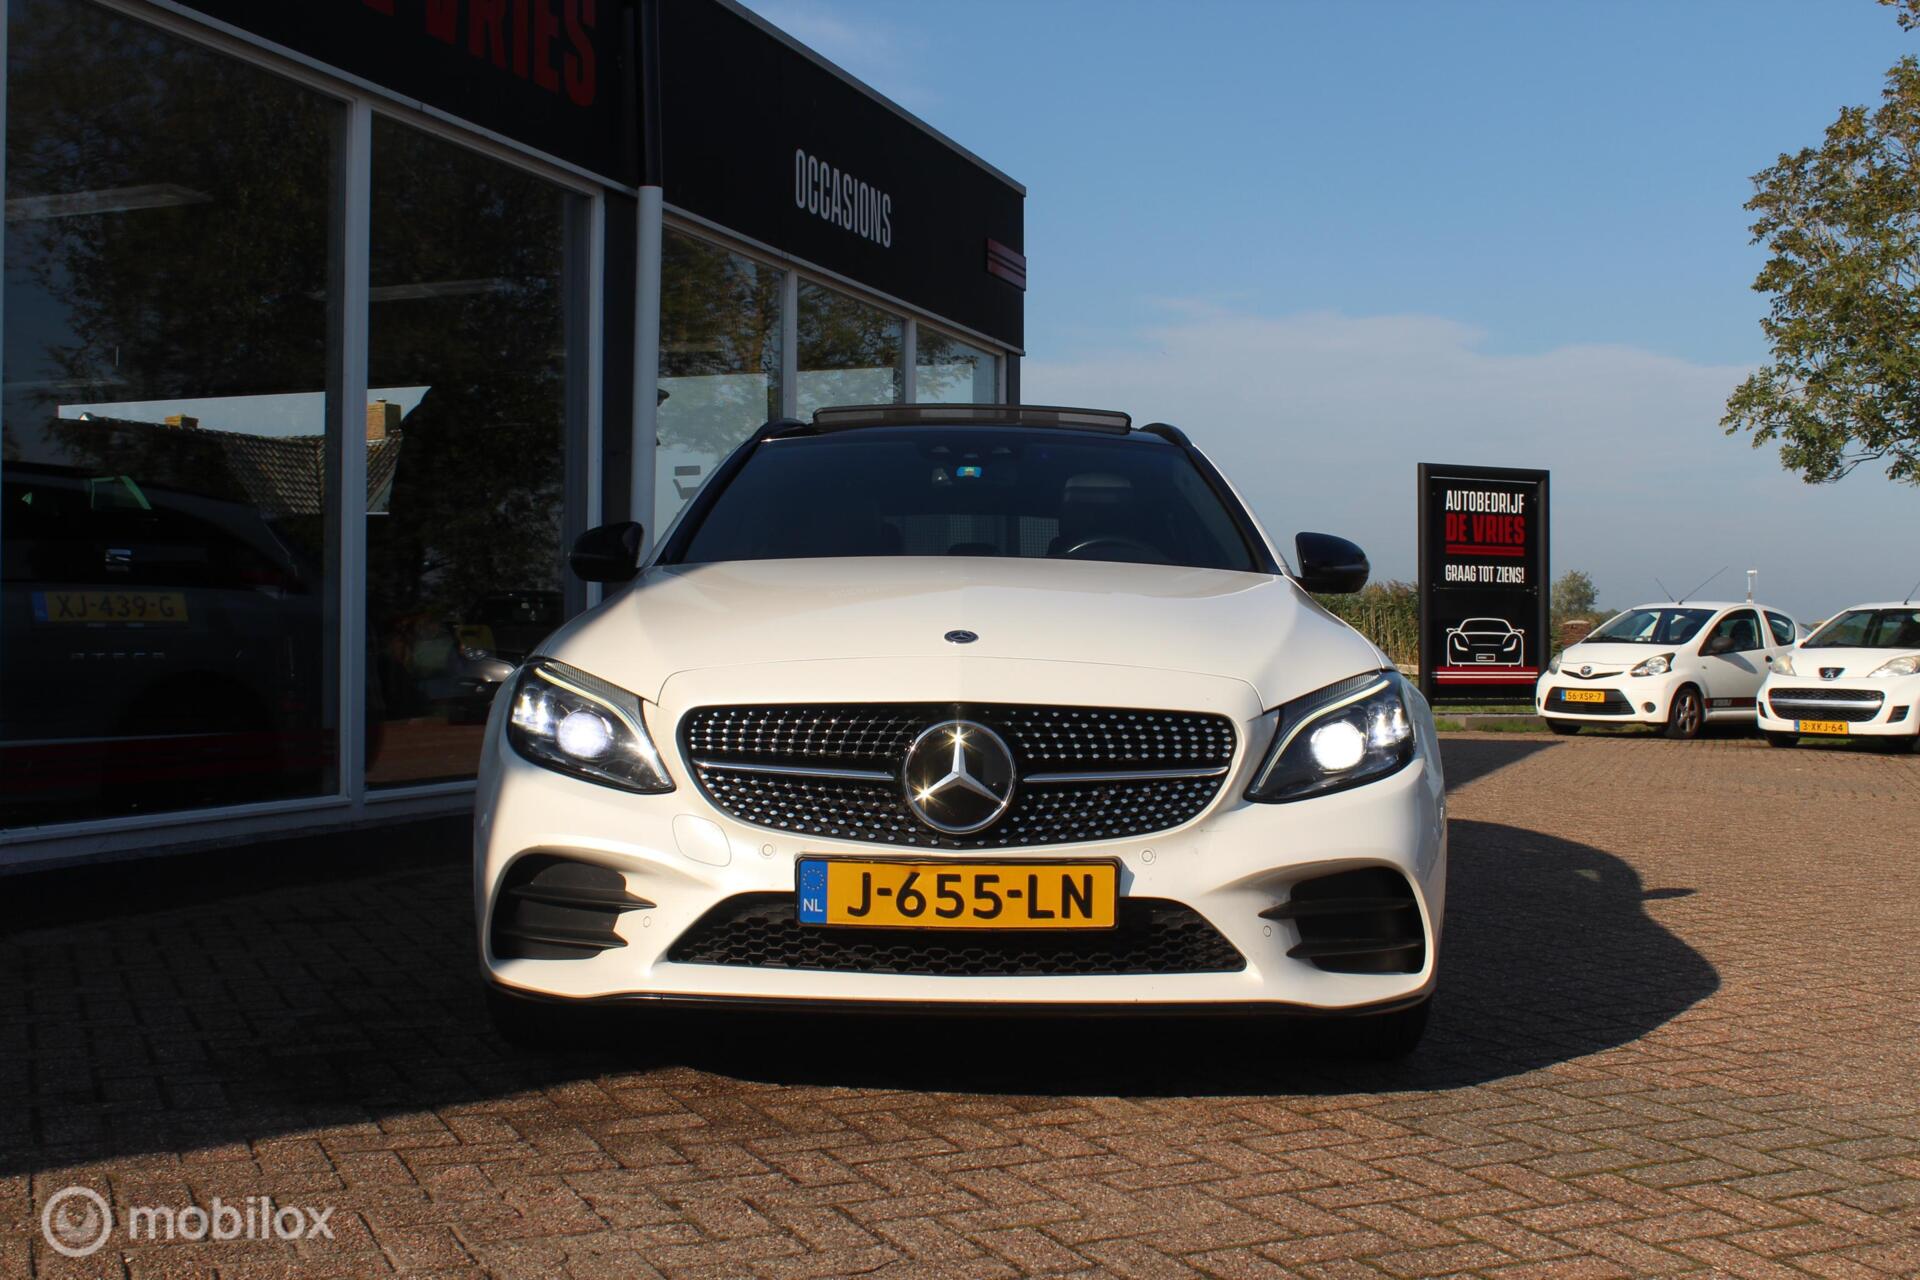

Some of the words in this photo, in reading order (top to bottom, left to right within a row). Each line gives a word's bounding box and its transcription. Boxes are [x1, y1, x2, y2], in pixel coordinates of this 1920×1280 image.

[795, 148, 892, 248] OCCASIONS
[1445, 489, 1525, 514] AUTOBEDRIJF
[1445, 513, 1467, 542] DE
[1472, 514, 1526, 544] VRIES
[1445, 564, 1477, 582] GRAAG
[1478, 565, 1495, 583] TOT
[1496, 566, 1525, 584] ZIENS!
[55, 594, 175, 618] XJ-439-G
[1567, 691, 1602, 702] 56-XSR-7
[1802, 722, 1844, 733] 3-XKJ-64
[803, 898, 823, 912] NL
[847, 871, 1093, 920] J-655-LN
